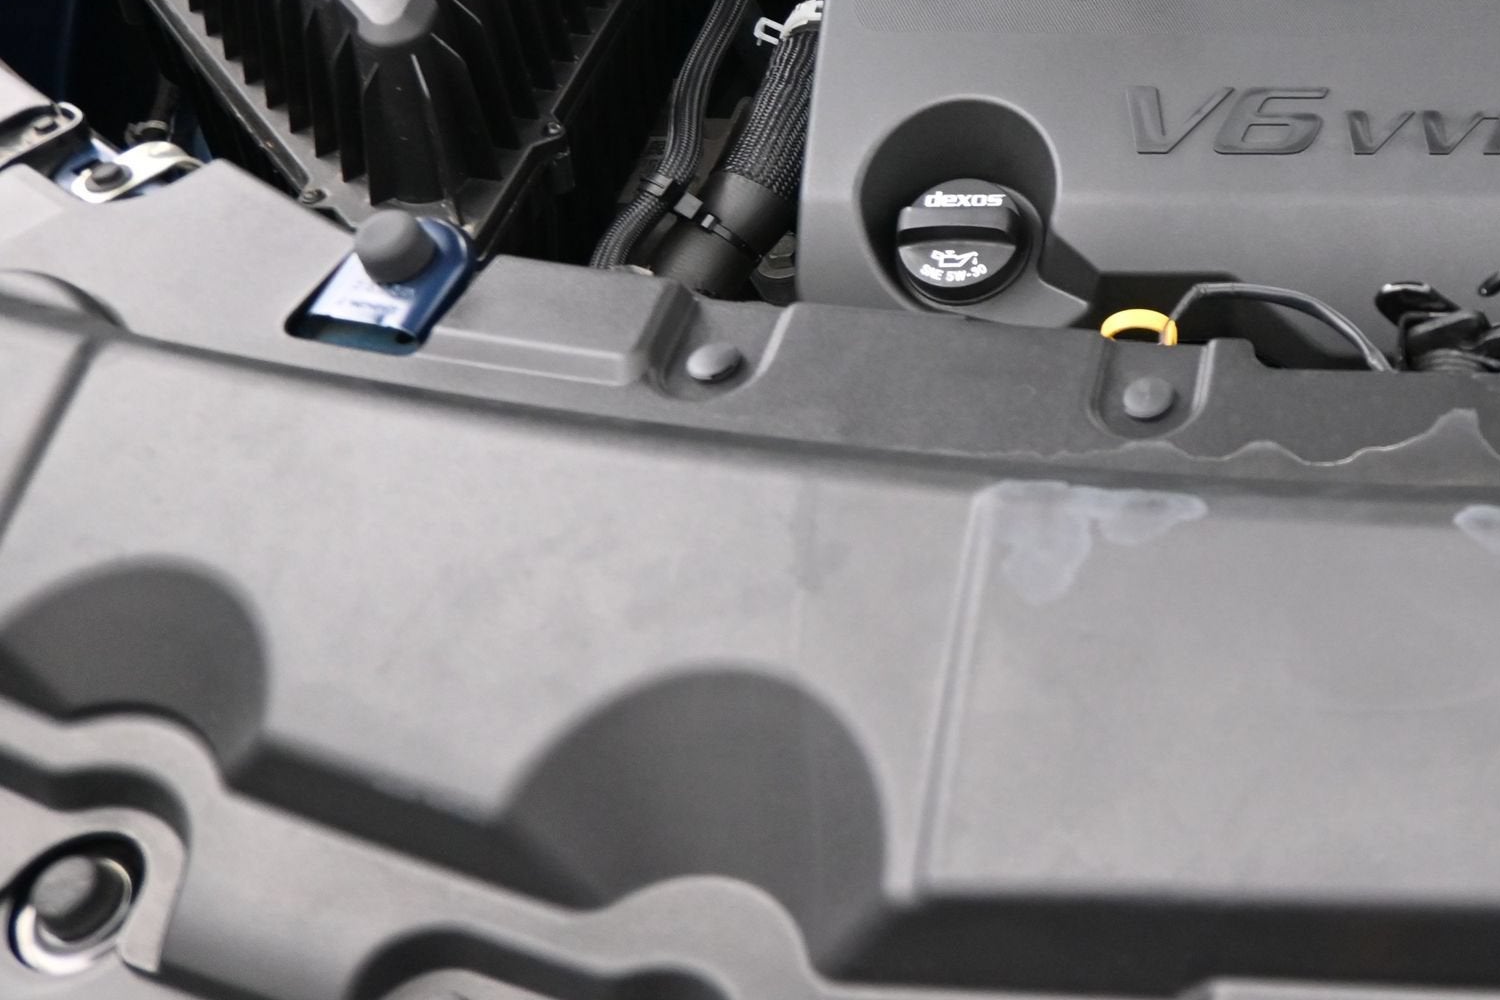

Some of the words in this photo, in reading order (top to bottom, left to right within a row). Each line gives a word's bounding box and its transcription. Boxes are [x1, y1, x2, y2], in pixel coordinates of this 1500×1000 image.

[1124, 84, 1329, 155] V6
[924, 190, 1007, 208] dexos
[945, 263, 988, 282] 5W-30
